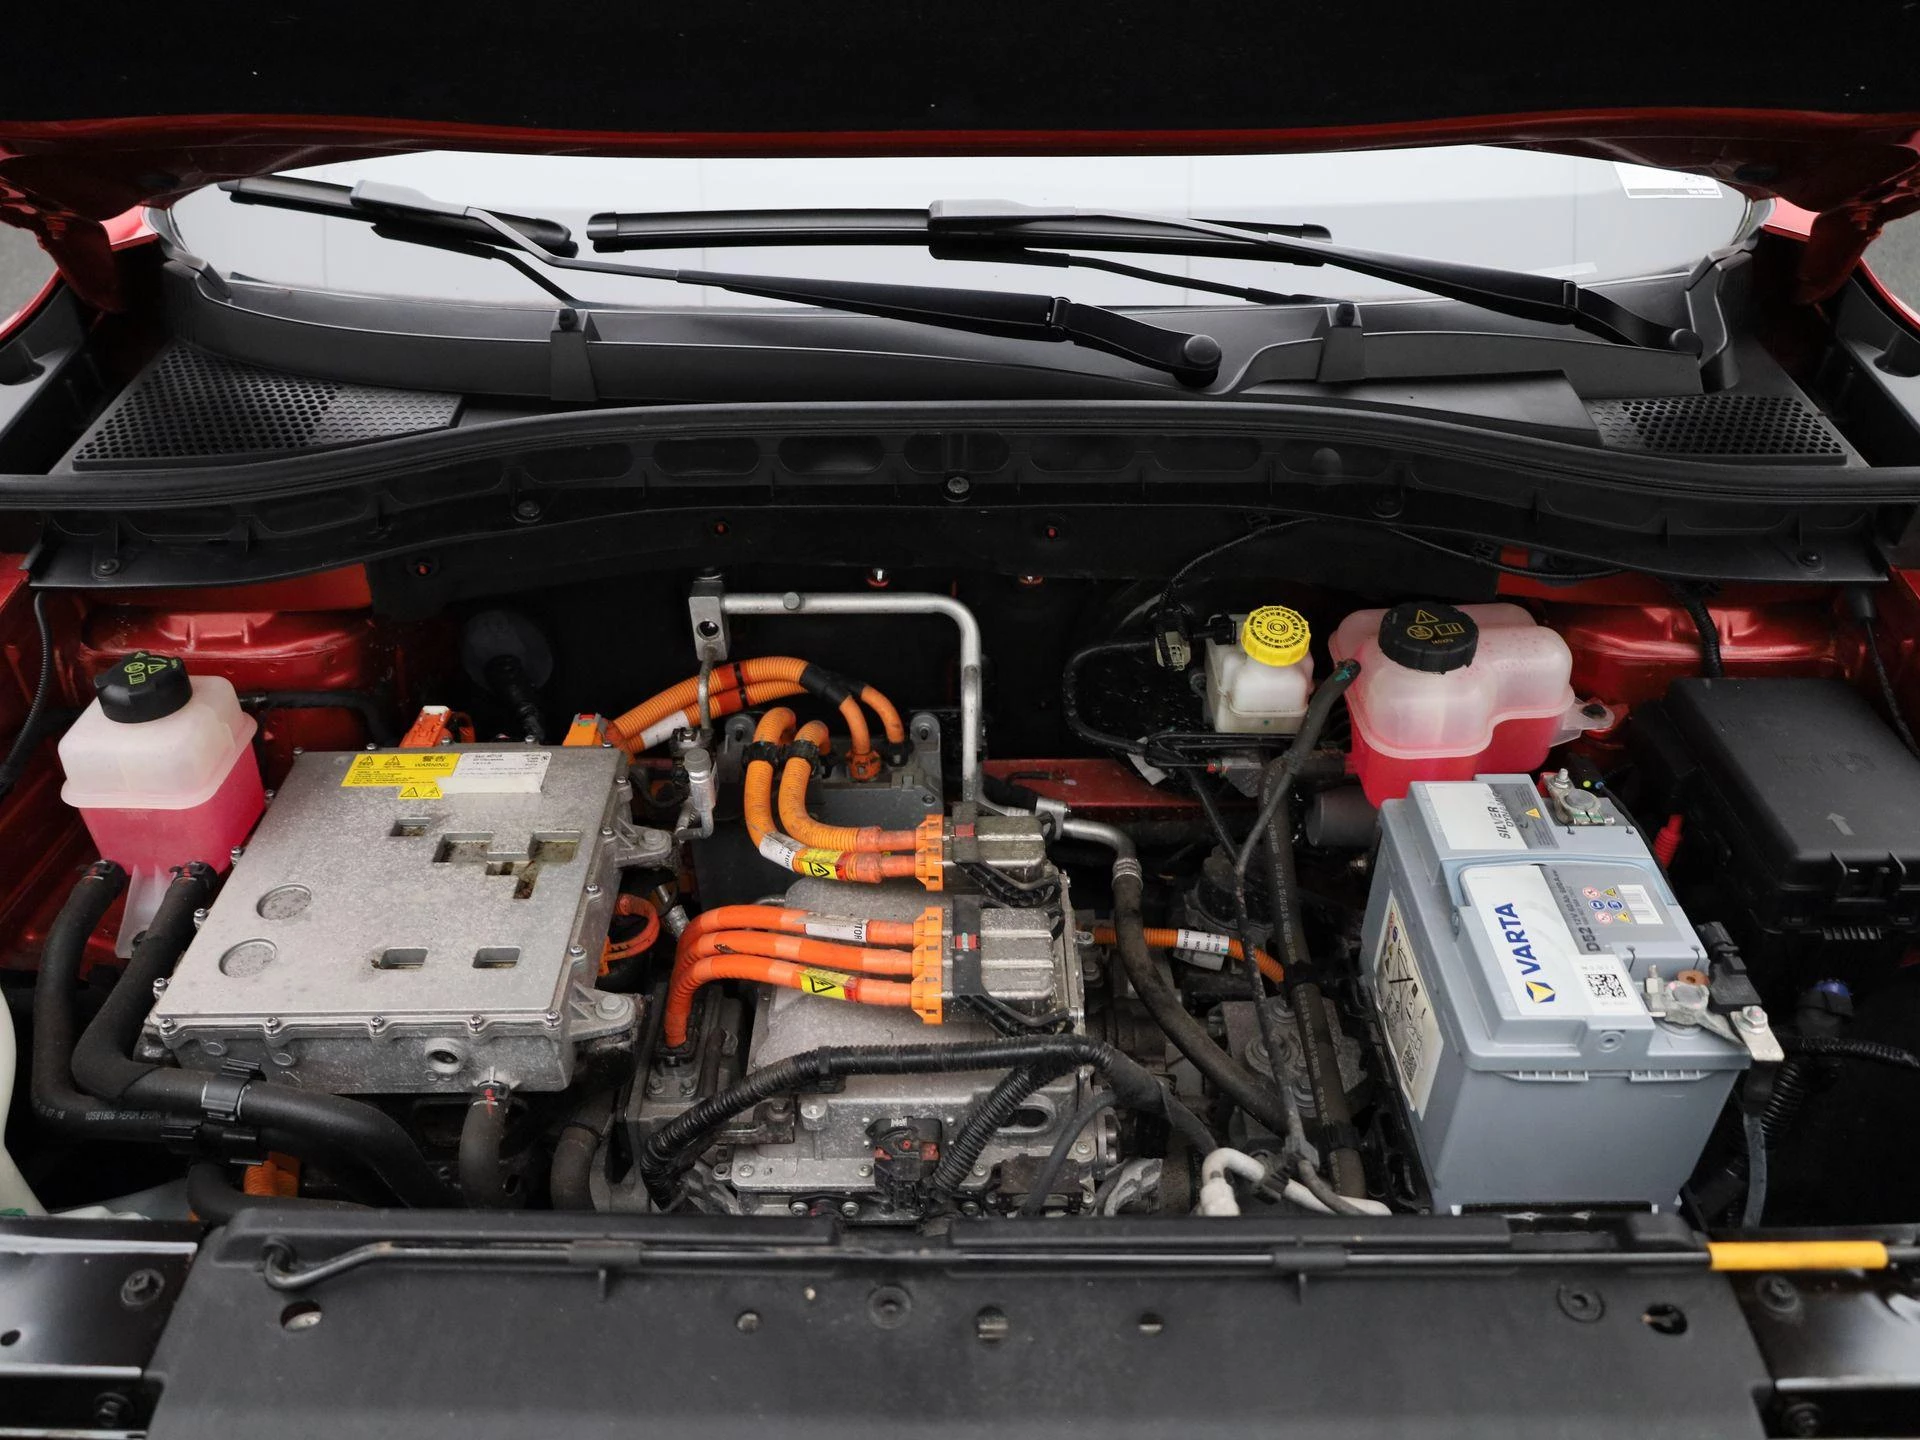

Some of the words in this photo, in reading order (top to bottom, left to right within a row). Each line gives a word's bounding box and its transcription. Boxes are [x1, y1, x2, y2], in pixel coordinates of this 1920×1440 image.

[1487, 806, 1511, 839] SILVER
[1494, 903, 1541, 975] VARTA
[1579, 927, 1601, 952] D52
